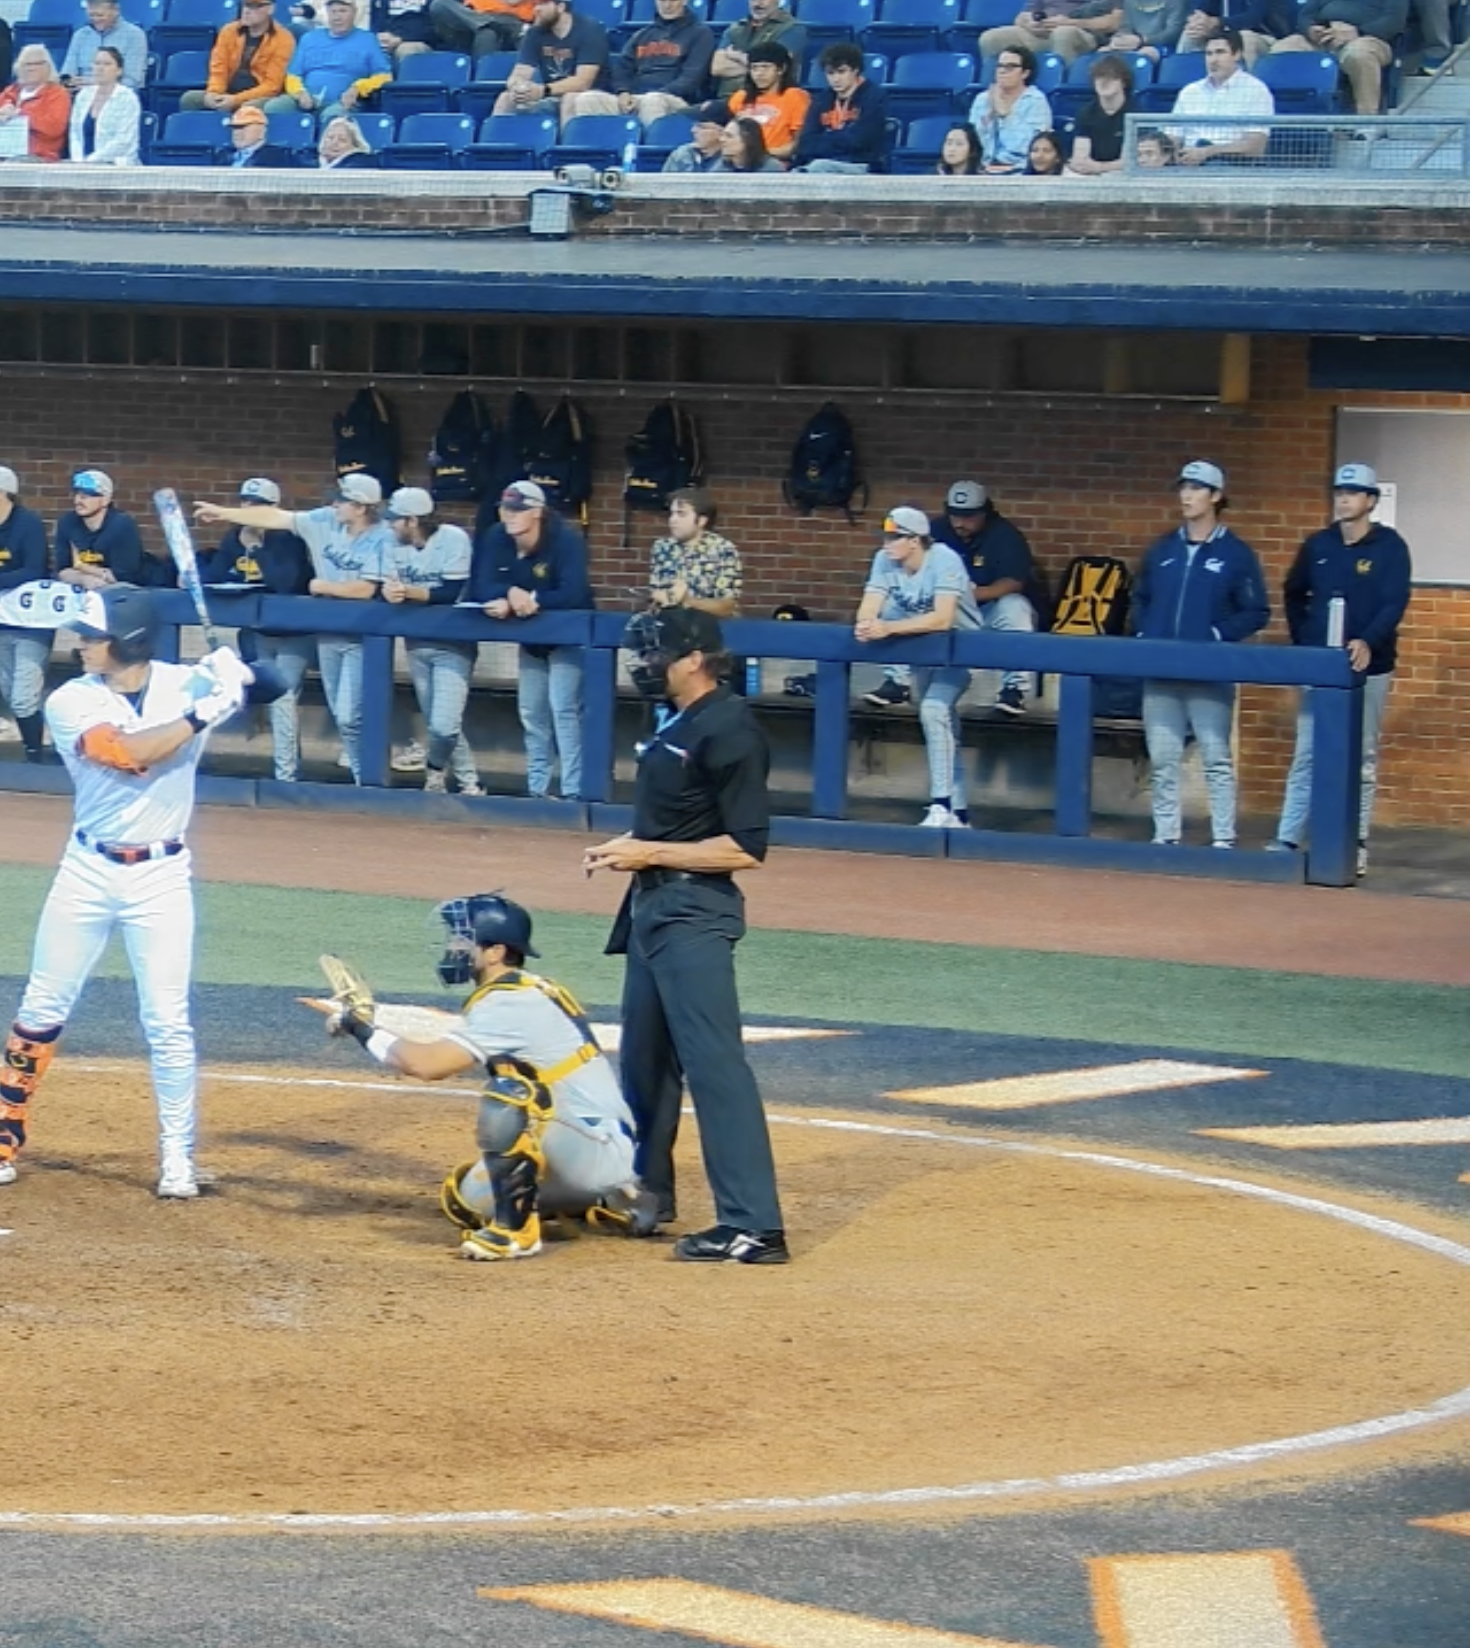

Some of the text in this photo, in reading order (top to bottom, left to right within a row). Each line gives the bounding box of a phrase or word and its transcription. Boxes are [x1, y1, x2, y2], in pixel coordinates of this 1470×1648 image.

[954, 493, 968, 505] C
[19, 592, 34, 609] G
[52, 595, 66, 612] G
